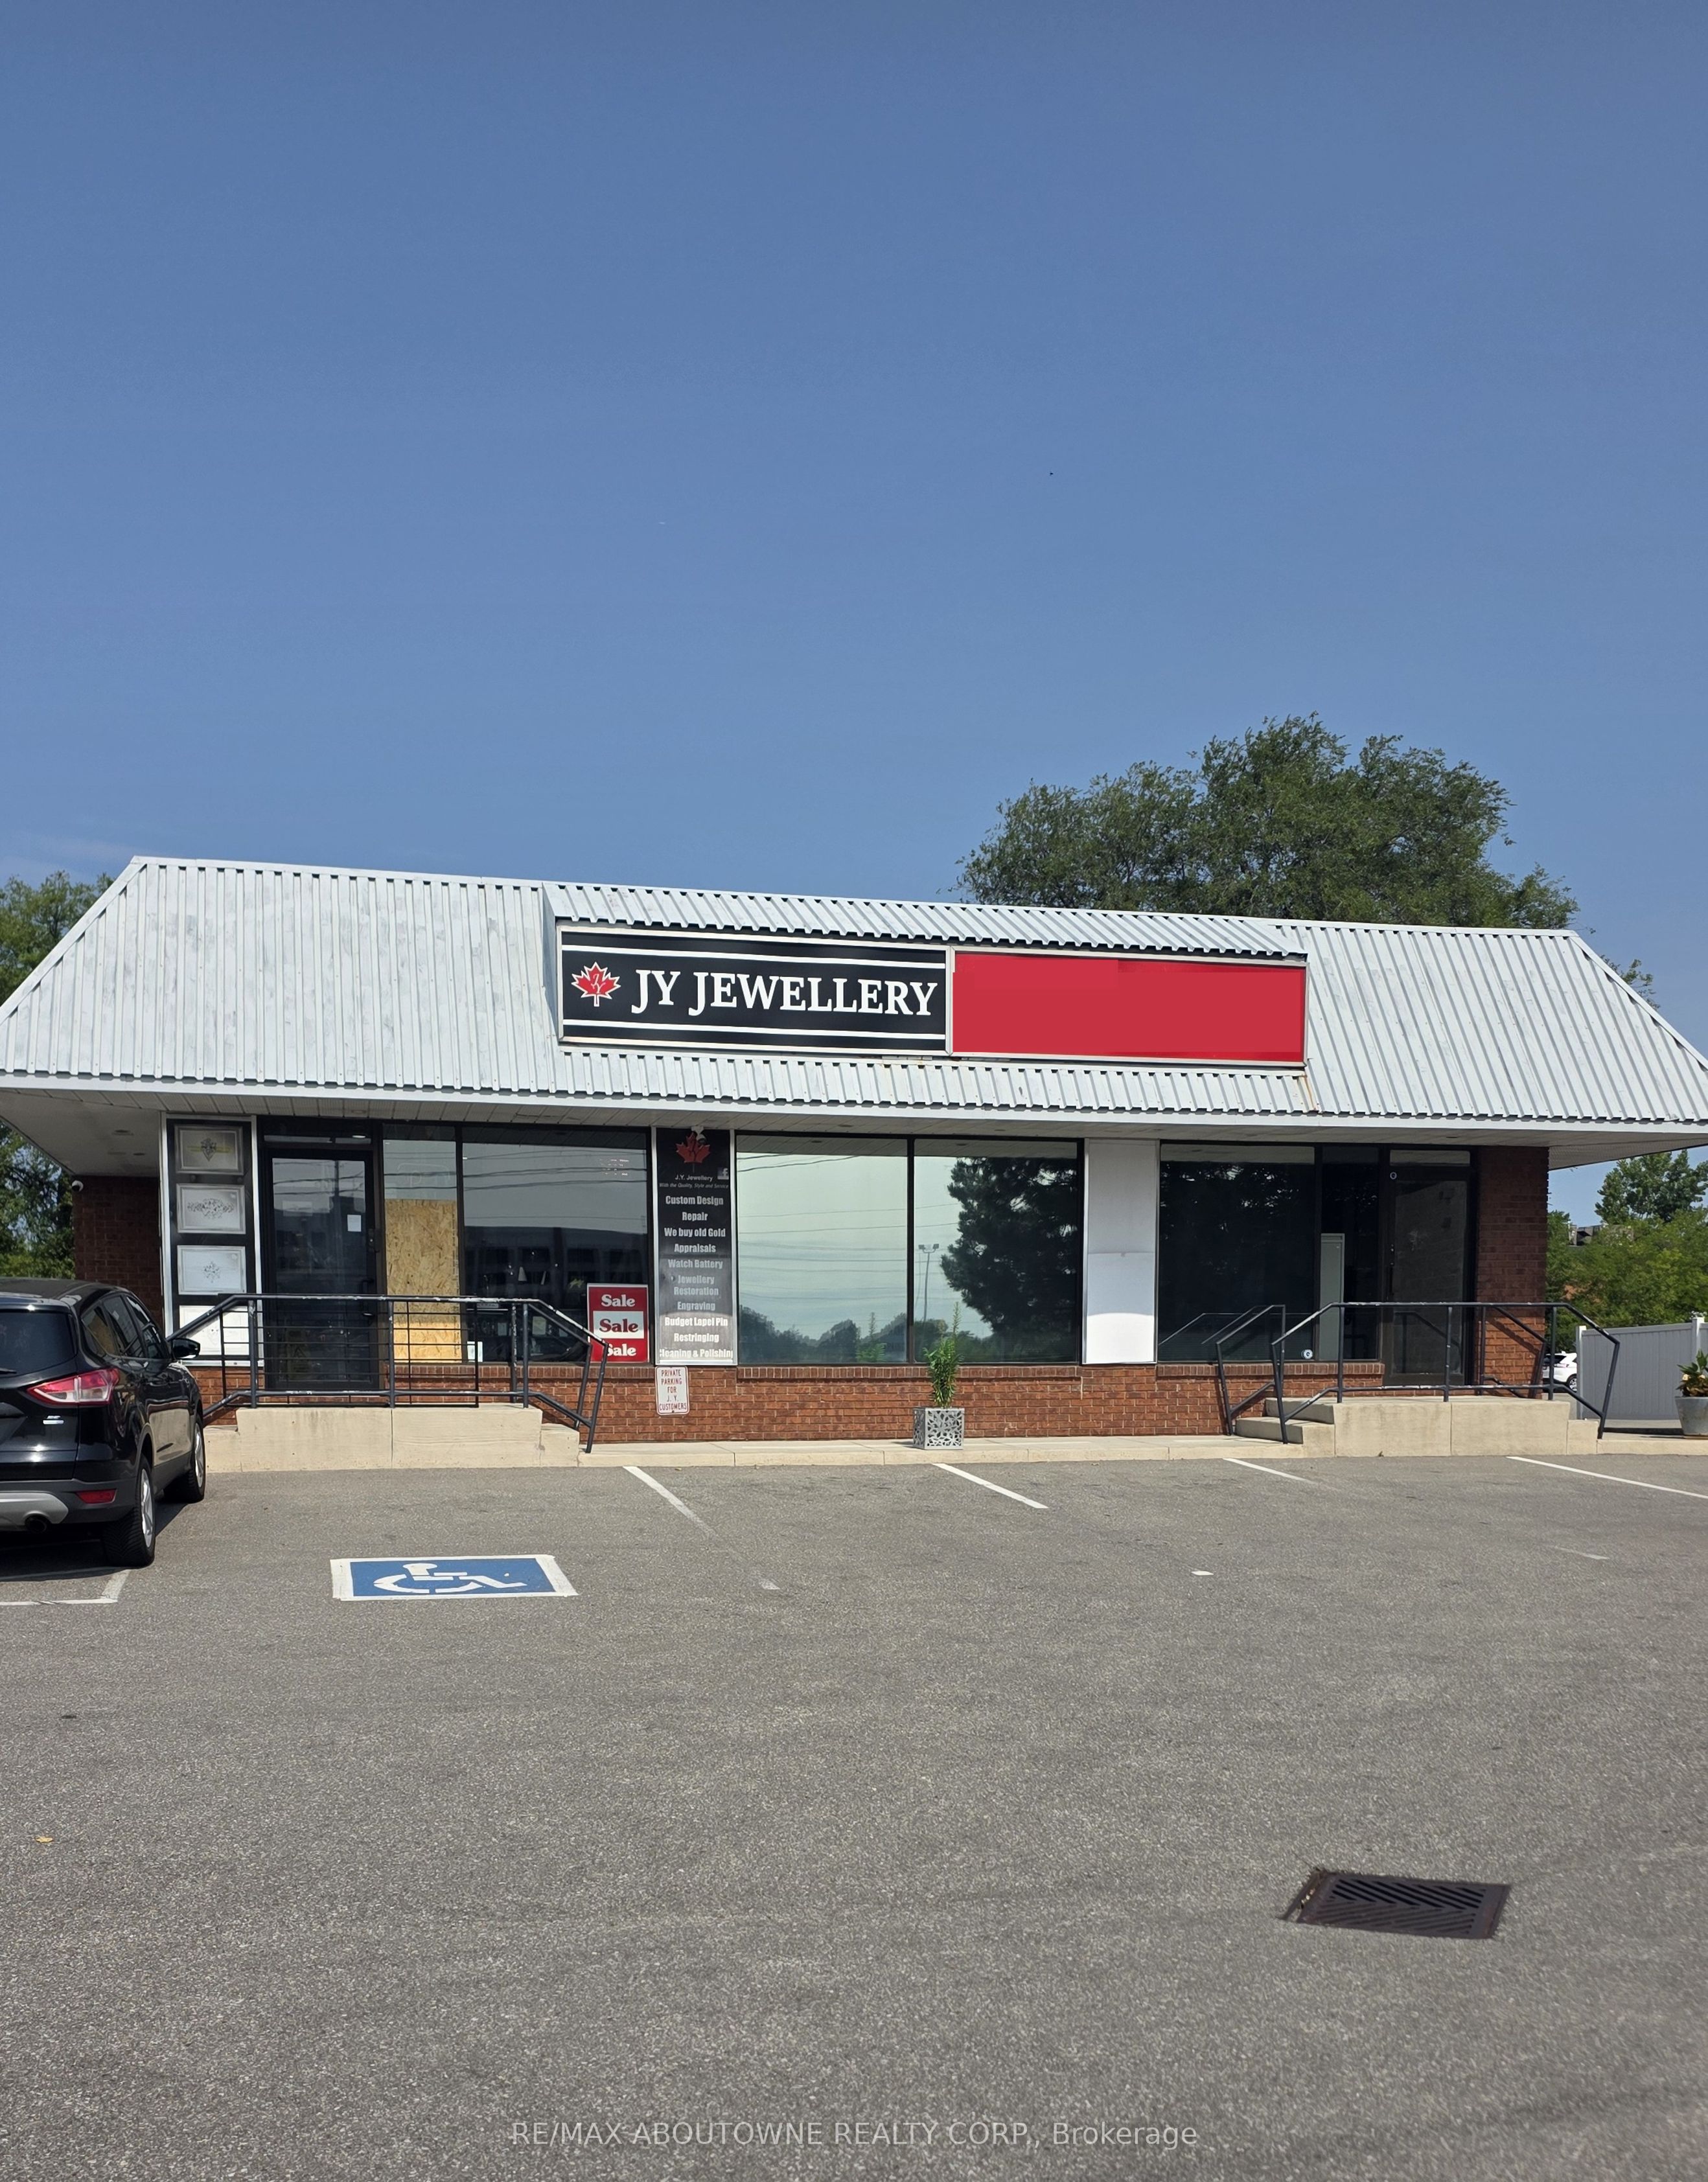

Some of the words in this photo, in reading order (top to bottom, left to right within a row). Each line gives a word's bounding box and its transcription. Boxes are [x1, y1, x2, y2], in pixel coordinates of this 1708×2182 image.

[632, 969, 680, 1014] JY
[688, 972, 938, 1016] JEWELLERY
[665, 1195, 695, 1204] Custom
[697, 1196, 724, 1206] Design
[682, 1212, 708, 1221] Repair
[664, 1228, 677, 1237] We
[678, 1228, 693, 1237] buy
[694, 1228, 707, 1237] old
[708, 1228, 726, 1237] Gold
[674, 1244, 716, 1254] Appraisals
[667, 1259, 693, 1268] Watch
[694, 1259, 723, 1269] Battery
[678, 1275, 715, 1284] Jewellery
[674, 1287, 719, 1295] Restoration
[601, 1294, 636, 1307] Sale
[677, 1301, 715, 1311] Engraving
[599, 1318, 639, 1333] Sale
[665, 1316, 693, 1327] Budget
[694, 1317, 715, 1327] Lapel
[716, 1317, 728, 1326] Pin
[674, 1333, 719, 1342] Restringing
[700, 1349, 733, 1359] Polishin
